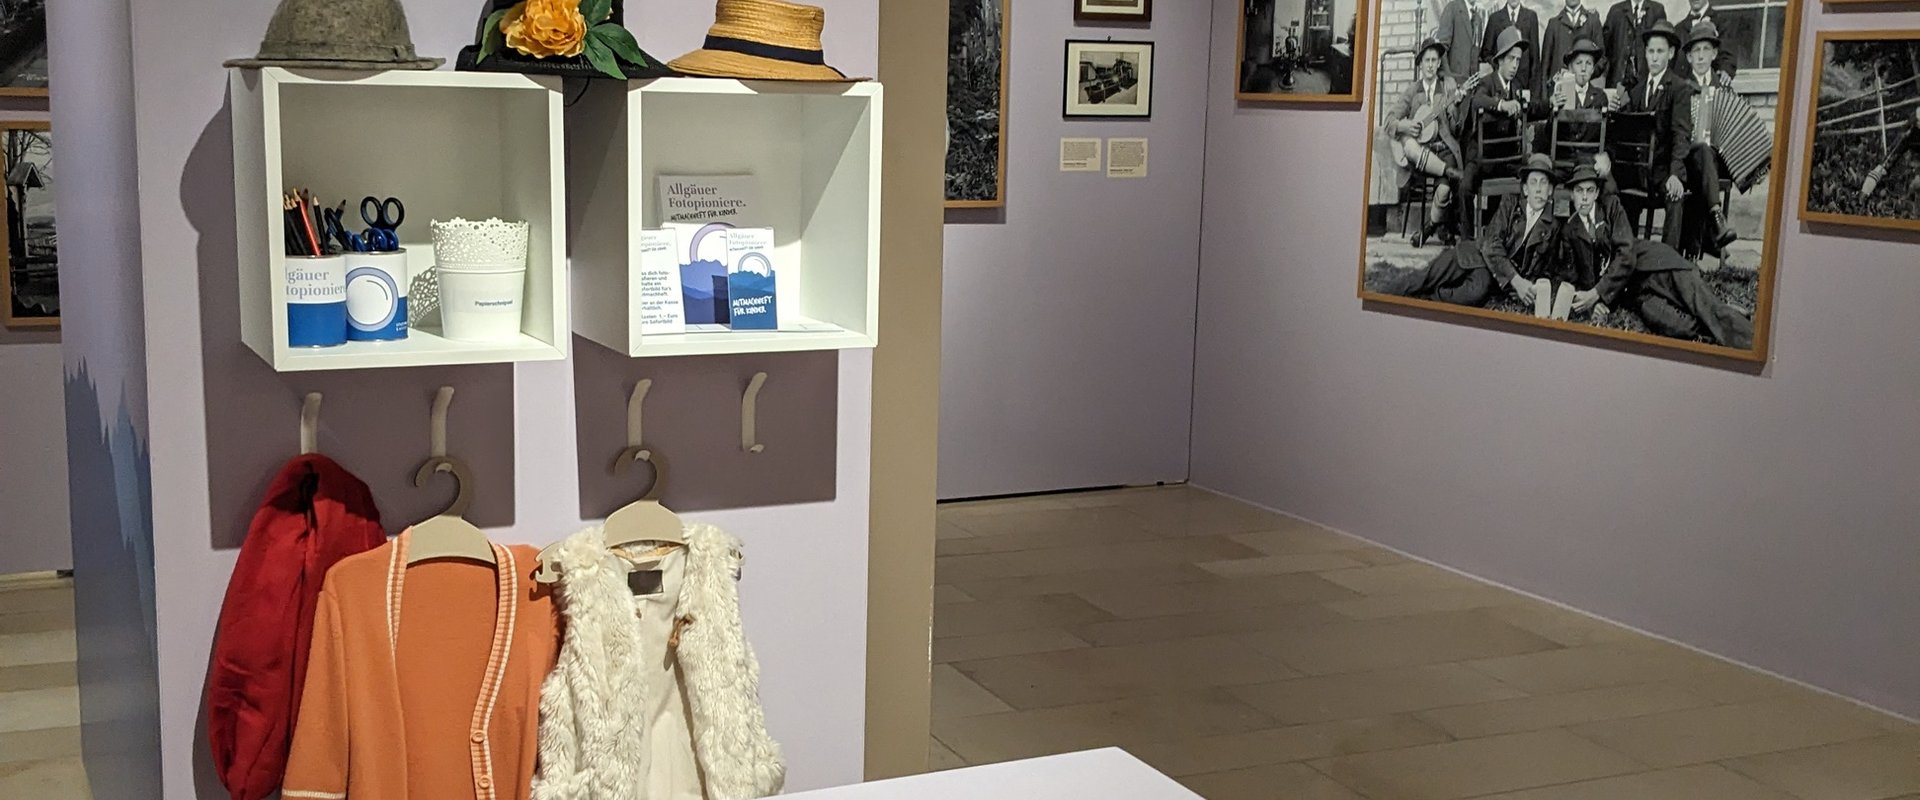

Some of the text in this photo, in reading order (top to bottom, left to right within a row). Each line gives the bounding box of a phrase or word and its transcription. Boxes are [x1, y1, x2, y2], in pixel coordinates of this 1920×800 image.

[668, 182, 718, 198] Allgäuer
[668, 197, 746, 211] Fotopioniere.
[719, 208, 738, 216] KINDER
[732, 295, 773, 307] MITMACHHEFT
[733, 306, 767, 316] FÜR KINDER
